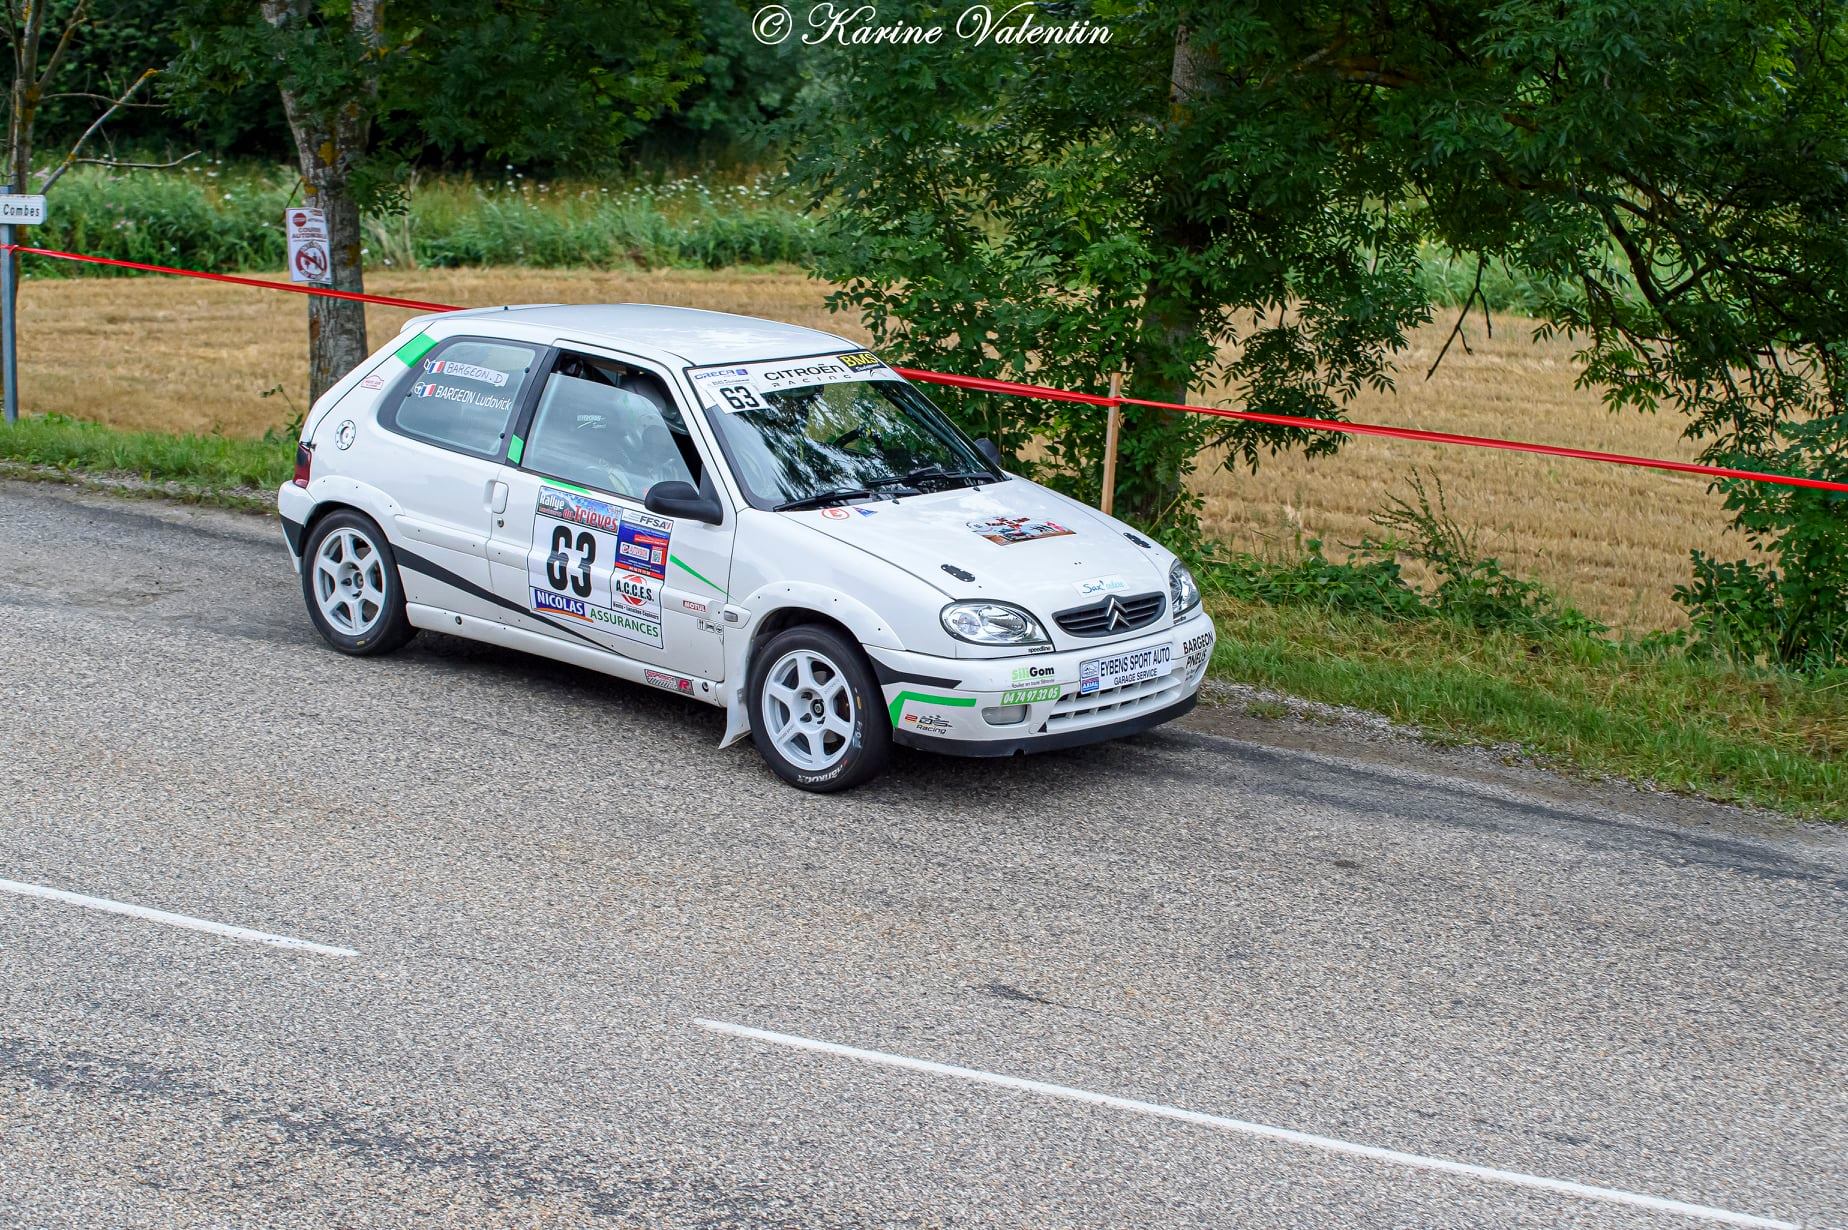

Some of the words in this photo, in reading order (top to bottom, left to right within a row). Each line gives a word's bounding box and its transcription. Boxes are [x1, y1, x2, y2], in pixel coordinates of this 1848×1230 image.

[3, 203, 40, 217] Combes
[839, 352, 878, 368] BMS
[435, 385, 476, 405] BARGEON
[475, 392, 513, 411] Ludovick
[719, 385, 761, 410] 63
[539, 489, 565, 511] Rallye
[639, 515, 667, 530] FFSA
[546, 525, 597, 598] 63
[615, 579, 655, 602] A.C.C.E.S.
[537, 590, 584, 615] NICOLAS
[590, 607, 660, 638] ASSURANCES
[1182, 631, 1214, 655] BARGEON
[1100, 656, 1129, 677] EYBENS
[1129, 651, 1152, 671] SPORT
[1152, 646, 1171, 666] AUTO
[1185, 648, 1207, 670] PNEUS
[1113, 673, 1136, 686] GARAGE
[1136, 668, 1158, 681] SERVICE
[916, 724, 947, 735] Racing
